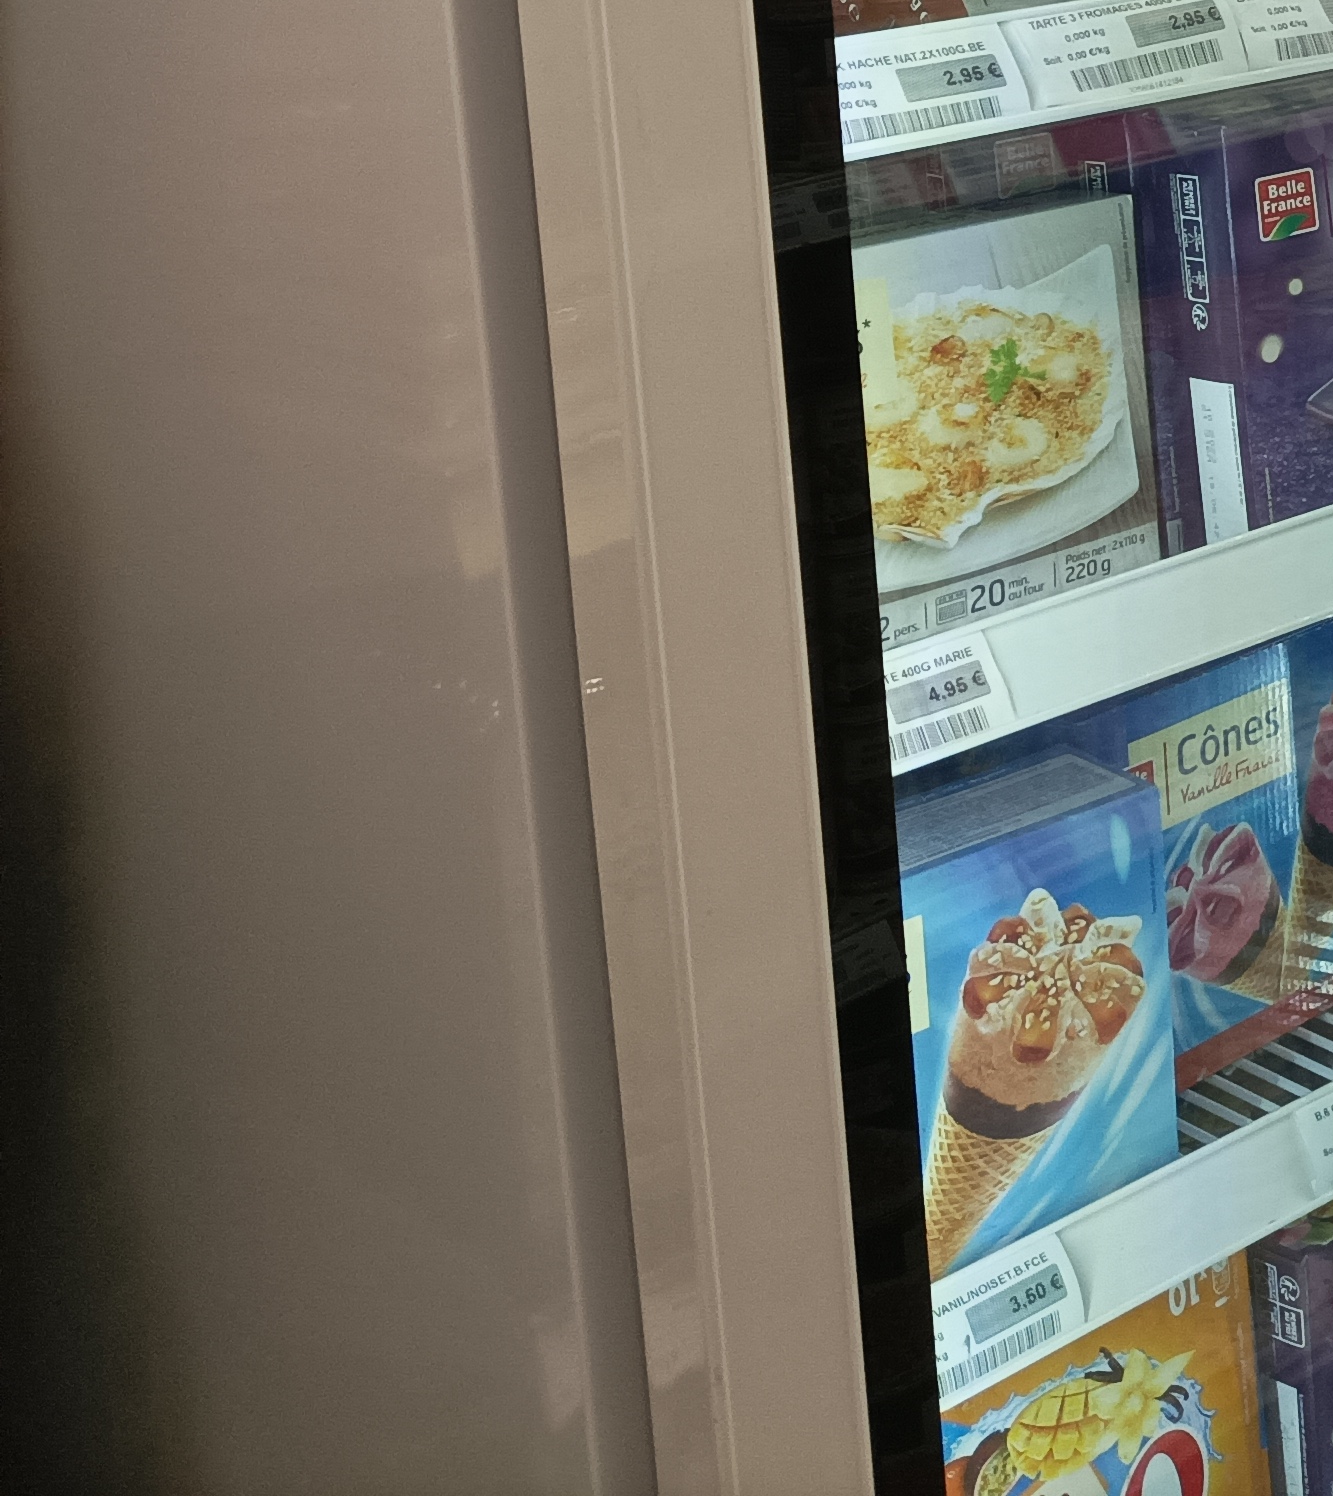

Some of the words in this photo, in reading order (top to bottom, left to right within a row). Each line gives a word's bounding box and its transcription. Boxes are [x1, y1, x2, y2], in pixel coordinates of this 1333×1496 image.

[1029, 16, 1067, 31] TARTE
[1069, 14, 1077, 24] 3
[1078, 1, 1143, 21] FROMAGES
[1168, 9, 1206, 31] 2,95
[1207, 6, 1221, 20] €
[1064, 31, 1092, 43] 0,000
[1093, 27, 1105, 38] kg
[847, 55, 892, 72] HACHE
[943, 65, 984, 87] 2,95
[988, 62, 1003, 79] €
[1267, 178, 1306, 199] Belle
[1262, 192, 1312, 215] France
[1065, 550, 1090, 564] Poids
[1065, 562, 1098, 583] 220
[1101, 558, 1112, 576] g
[1009, 591, 1022, 602] au
[1024, 582, 1045, 599] four
[894, 623, 920, 641] pers.
[970, 578, 1006, 613] 20
[1008, 576, 1030, 590] min.
[901, 660, 932, 679] 400G
[934, 646, 973, 669] MARIE
[928, 676, 969, 703] 4,95
[971, 670, 987, 686] €
[1177, 707, 1280, 775] Cônes
[1180, 765, 1233, 805] Vanille
[1009, 1283, 1047, 1315] 3,60
[1049, 1272, 1065, 1293] €
